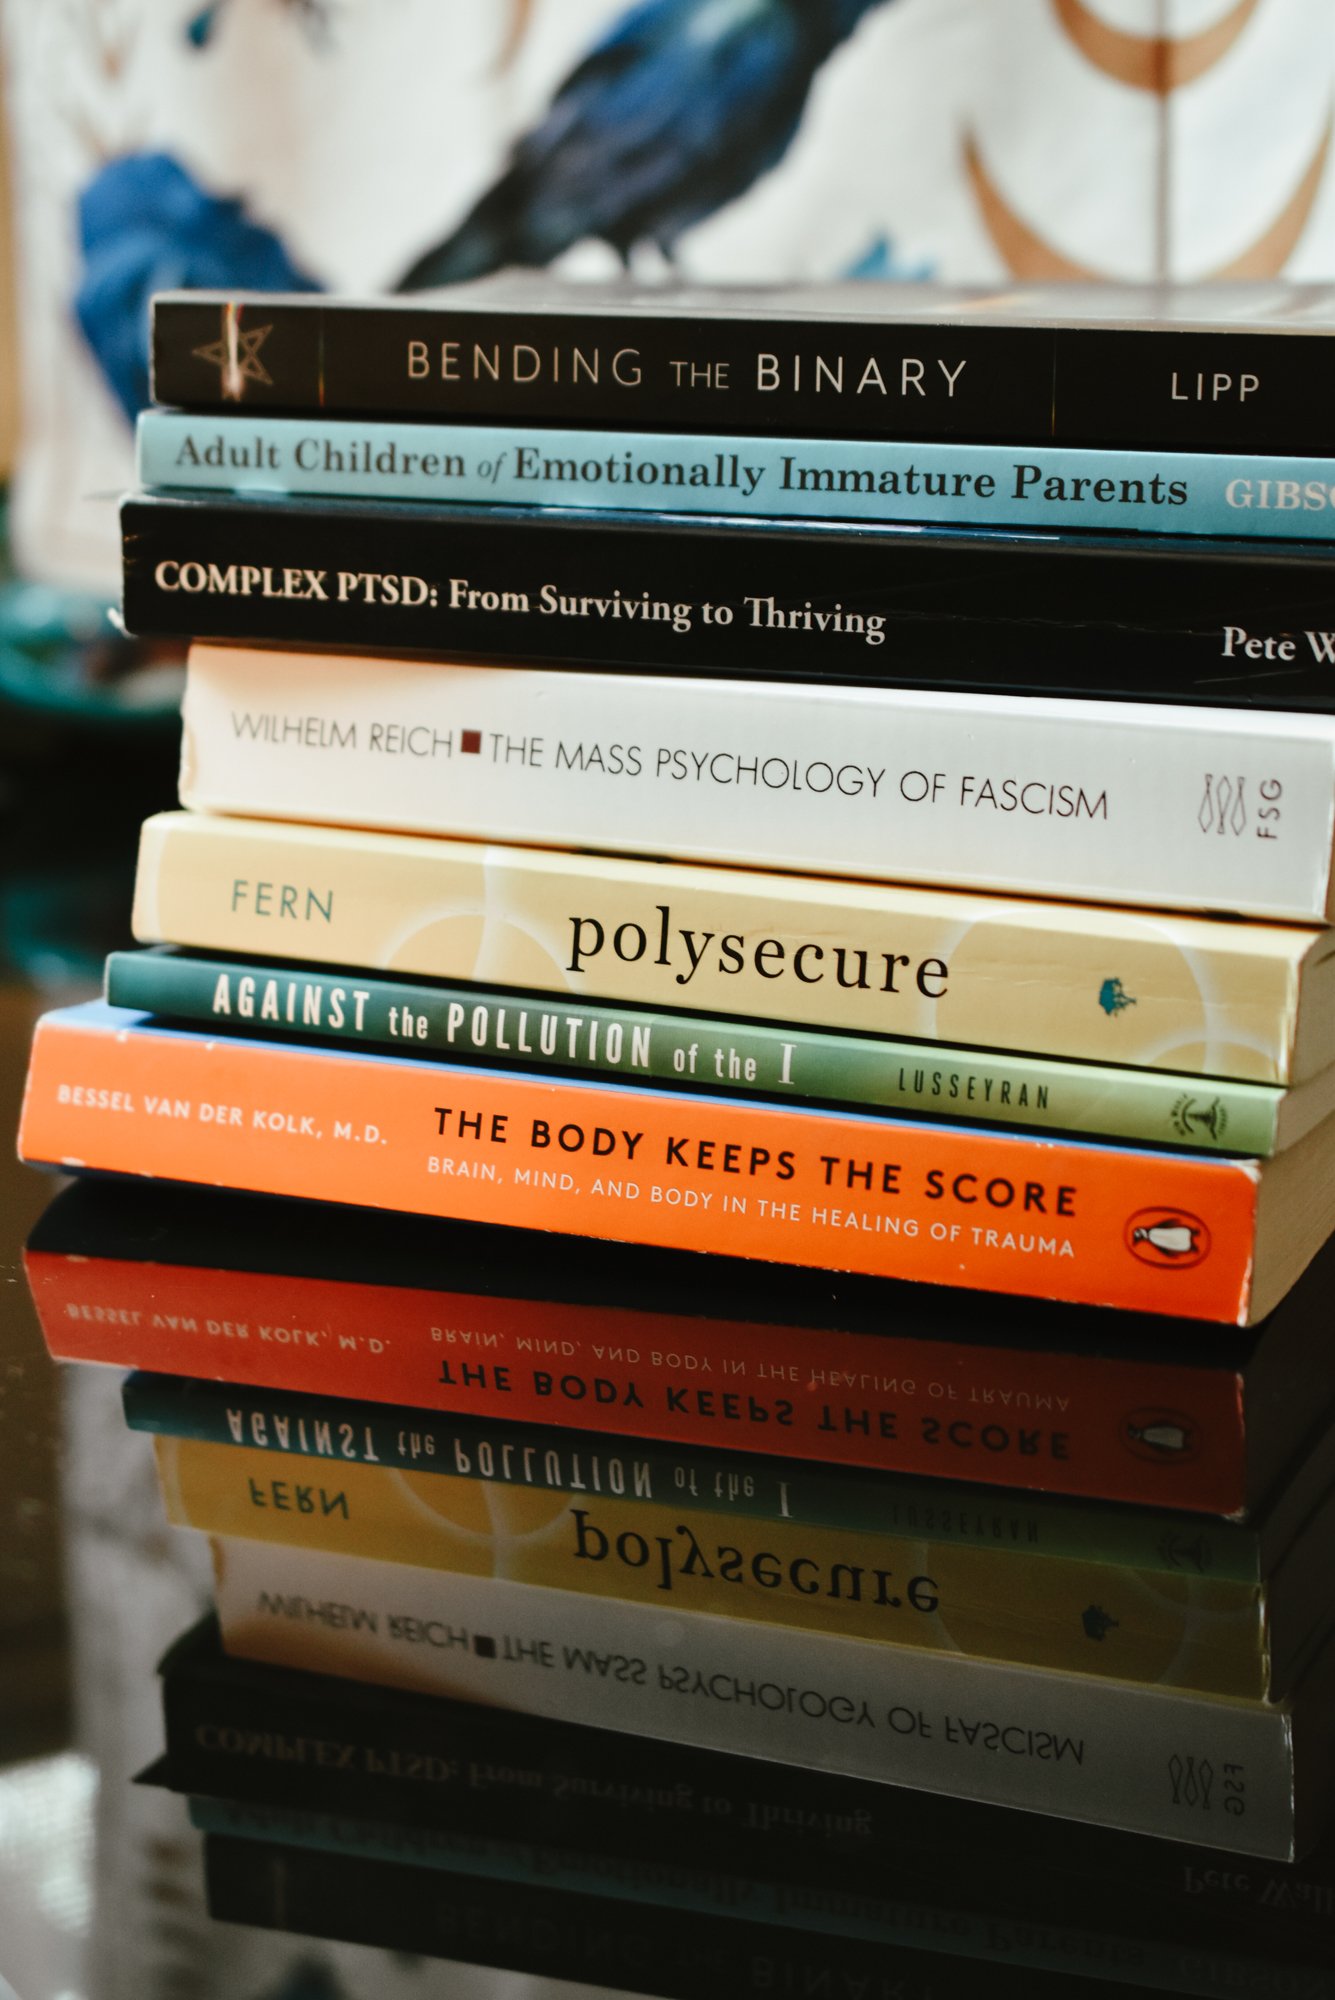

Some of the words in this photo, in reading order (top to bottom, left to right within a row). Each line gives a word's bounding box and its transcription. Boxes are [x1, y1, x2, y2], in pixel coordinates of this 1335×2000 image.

[408, 341, 642, 386] BENDING
[669, 361, 730, 389] THE
[757, 353, 966, 397] BINARY
[1171, 372, 1260, 402] LIPP
[176, 435, 281, 470] Adult
[295, 436, 465, 477] Children
[478, 452, 507, 484] of
[514, 446, 765, 496] Emotionally
[779, 456, 996, 498] Immature
[1011, 464, 1189, 505] Parents
[1225, 479, 1335, 511] GIBS
[155, 561, 328, 600] COMPLEX
[338, 571, 438, 608] PTSD:
[450, 579, 530, 611] From
[539, 586, 692, 632] Surviving
[702, 600, 733, 626] to
[745, 596, 886, 645] Thriving
[1221, 626, 1296, 661] Pete
[232, 711, 357, 750] WILHELM
[370, 724, 453, 757] REICH
[489, 733, 543, 767] THE
[555, 742, 642, 777] MASS
[656, 748, 886, 798] PSYCHOLOGY
[900, 770, 946, 803] OF
[961, 776, 1108, 820] FASCISM
[1256, 779, 1283, 839] FSG
[232, 879, 333, 924] FERN
[566, 905, 949, 999] polysecure
[212, 974, 370, 1031] AGAINST
[388, 1005, 428, 1040] the
[447, 1003, 651, 1069] POLLUTION
[673, 1043, 698, 1074] of
[714, 1048, 757, 1082] the
[776, 1042, 798, 1086] I
[57, 1084, 135, 1113] BESSEL
[143, 1095, 191, 1120] VAN
[198, 1100, 243, 1127] DER
[252, 1107, 323, 1140] KOLK,
[333, 1119, 388, 1146] M.D.
[899, 1067, 1049, 1111] LUSSEYRAN
[434, 1107, 508, 1144] THE
[531, 1118, 645, 1160] BODY
[666, 1137, 796, 1181] KEEPS
[820, 1155, 902, 1195] THE
[925, 1170, 1077, 1218] SCORE
[427, 1155, 501, 1183] BRAIN,
[514, 1168, 581, 1196] MIND,
[592, 1175, 640, 1200] AND
[650, 1186, 713, 1210] BODY
[722, 1194, 747, 1215] IN
[757, 1199, 802, 1223] THE
[811, 1205, 919, 1238] HEALING
[929, 1222, 962, 1244] OF
[971, 1226, 1075, 1259] TRAUMA
